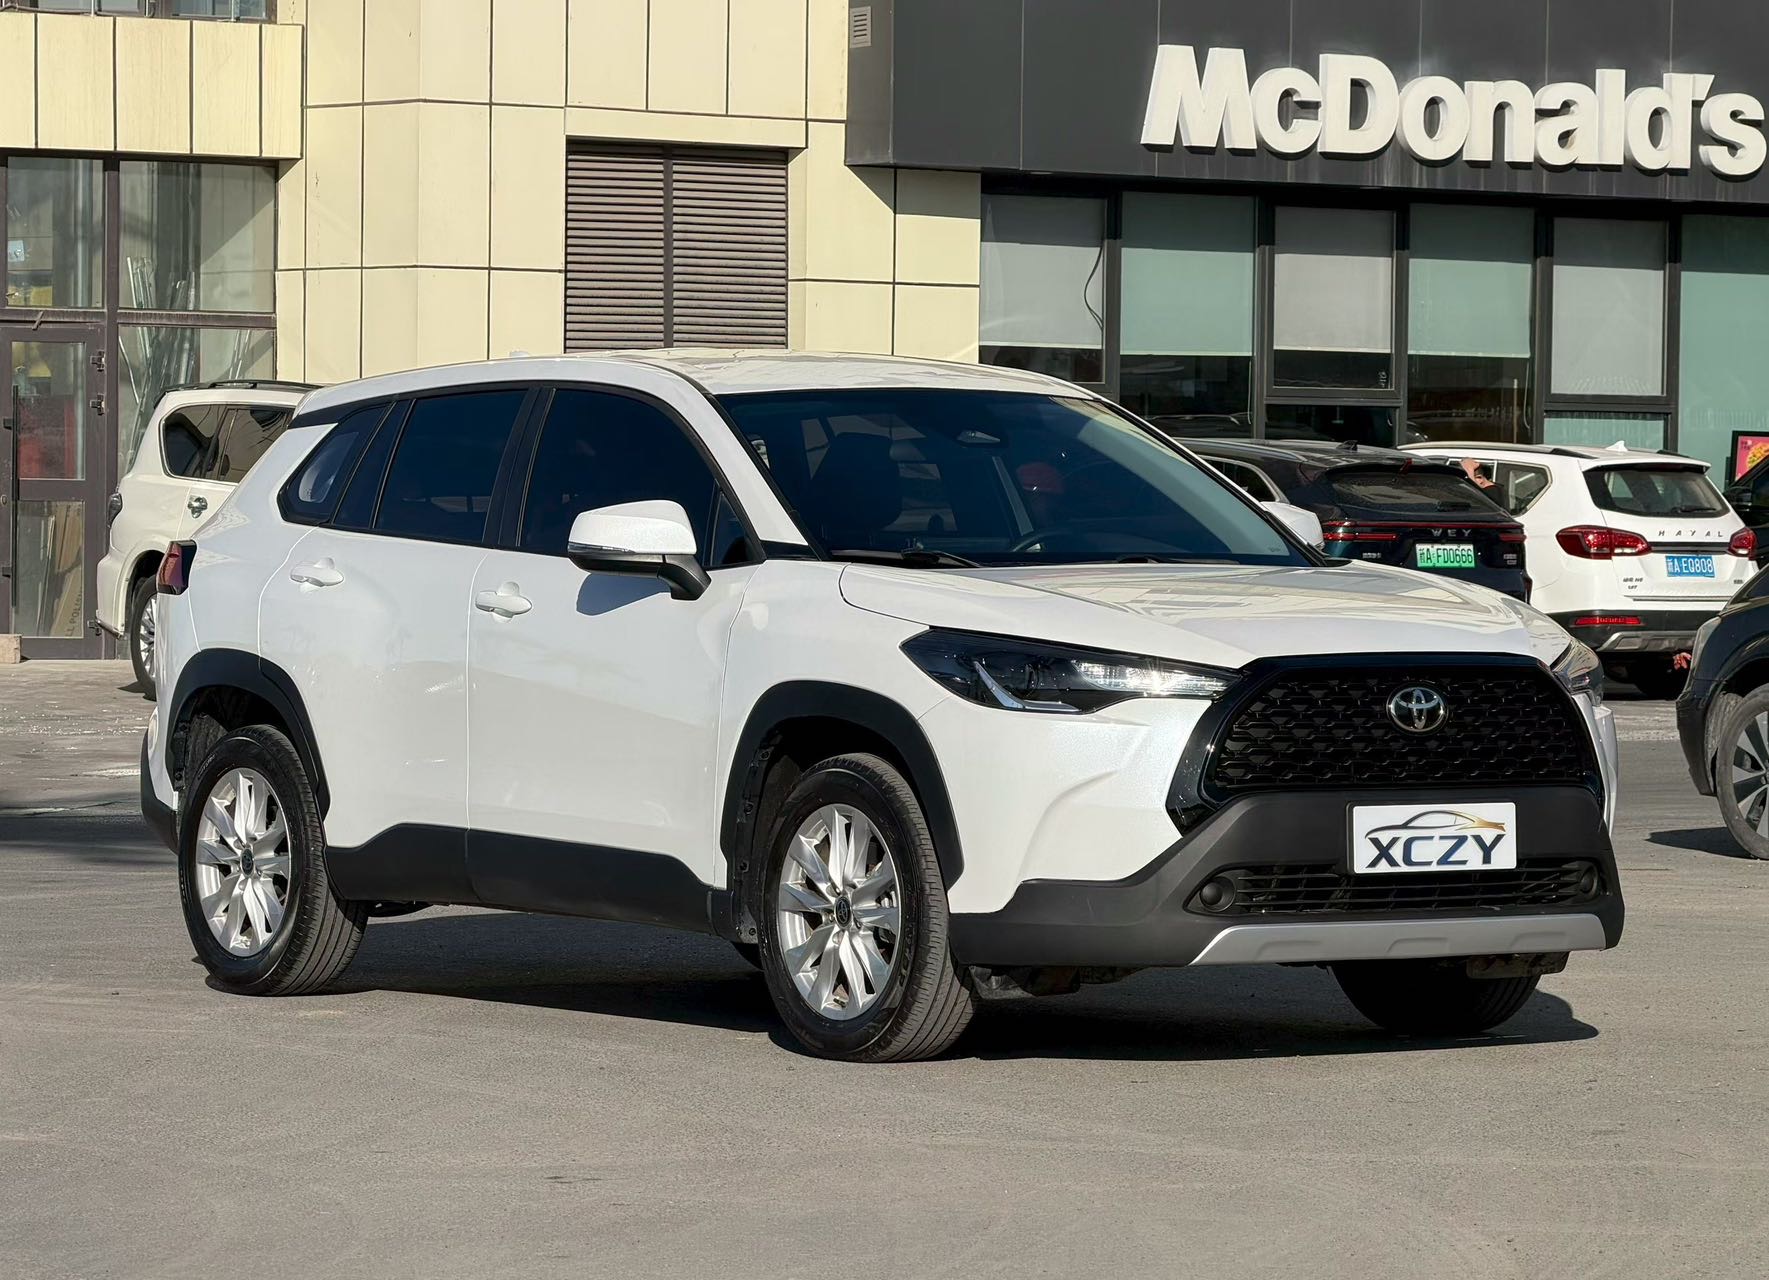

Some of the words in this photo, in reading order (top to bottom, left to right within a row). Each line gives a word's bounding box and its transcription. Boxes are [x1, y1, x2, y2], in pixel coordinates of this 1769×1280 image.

[1141, 44, 1768, 176] McDonald's
[1431, 529, 1473, 537] WEY
[1365, 834, 1507, 869] XCZY
